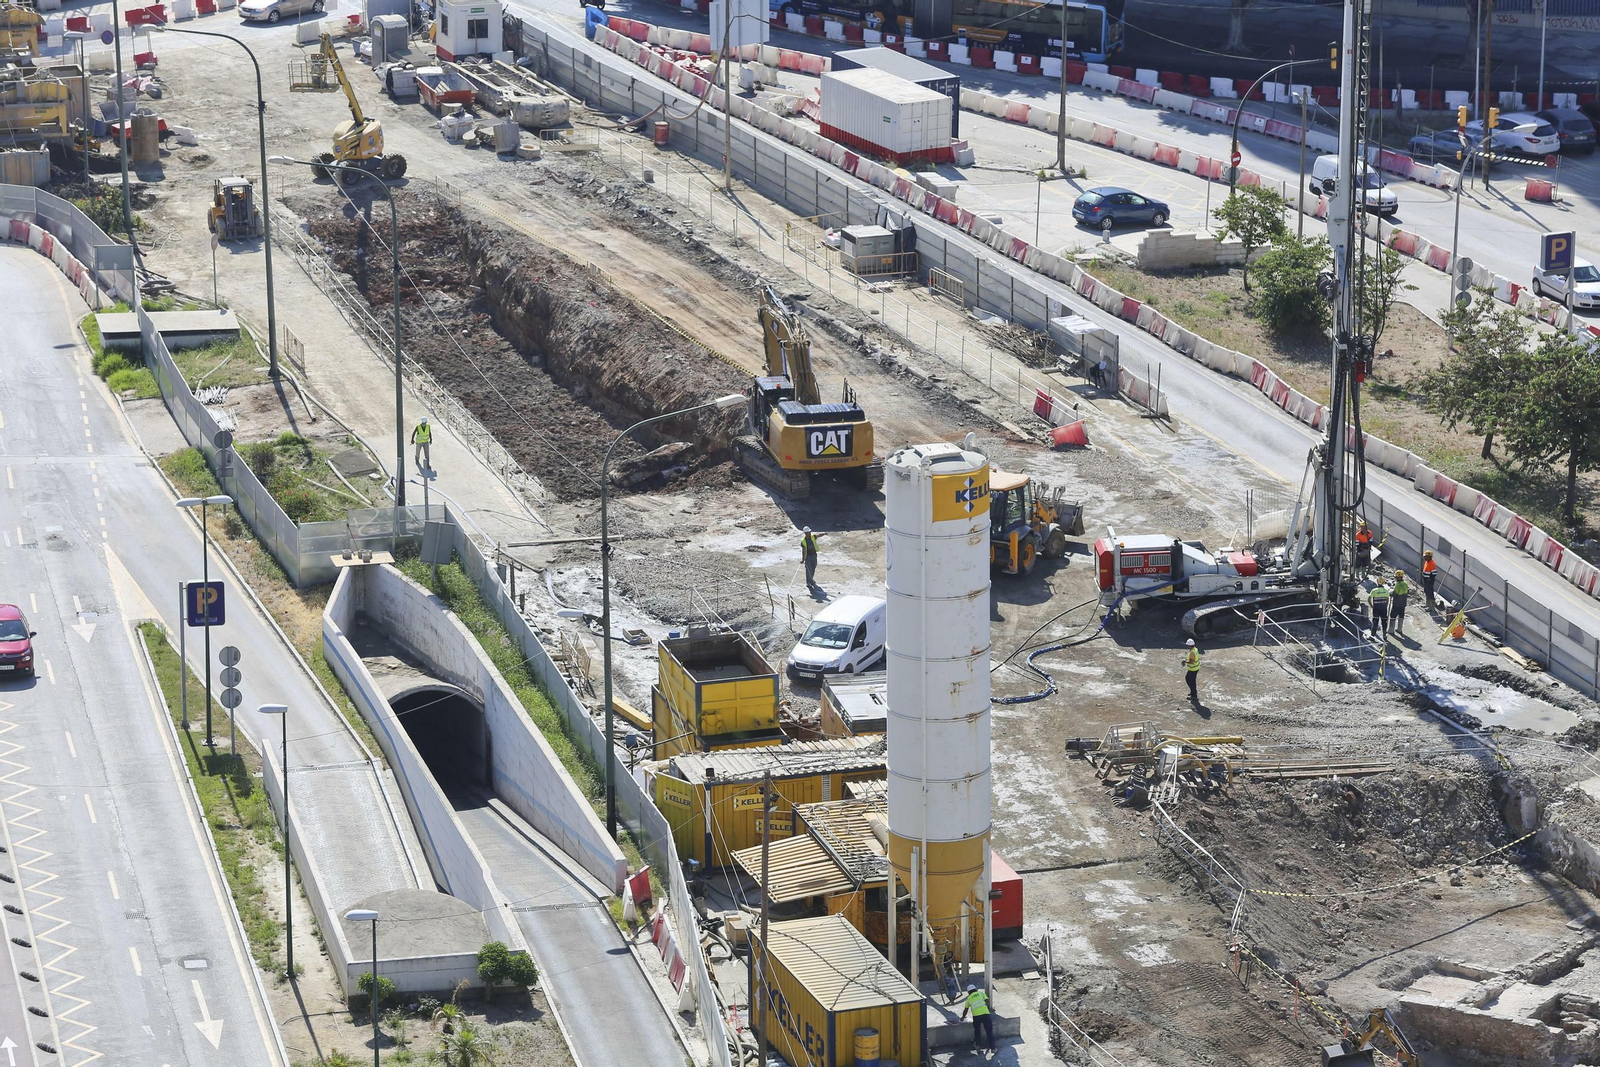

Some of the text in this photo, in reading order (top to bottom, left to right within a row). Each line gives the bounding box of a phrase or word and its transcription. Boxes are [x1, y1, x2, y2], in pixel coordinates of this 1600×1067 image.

[1551, 238, 1567, 260] P
[810, 429, 849, 455] CAT
[196, 587, 218, 614] P
[669, 794, 691, 806] KELLER
[741, 797, 765, 806] KELL
[770, 823, 792, 831] ELLE
[768, 981, 825, 1067] KELLER
